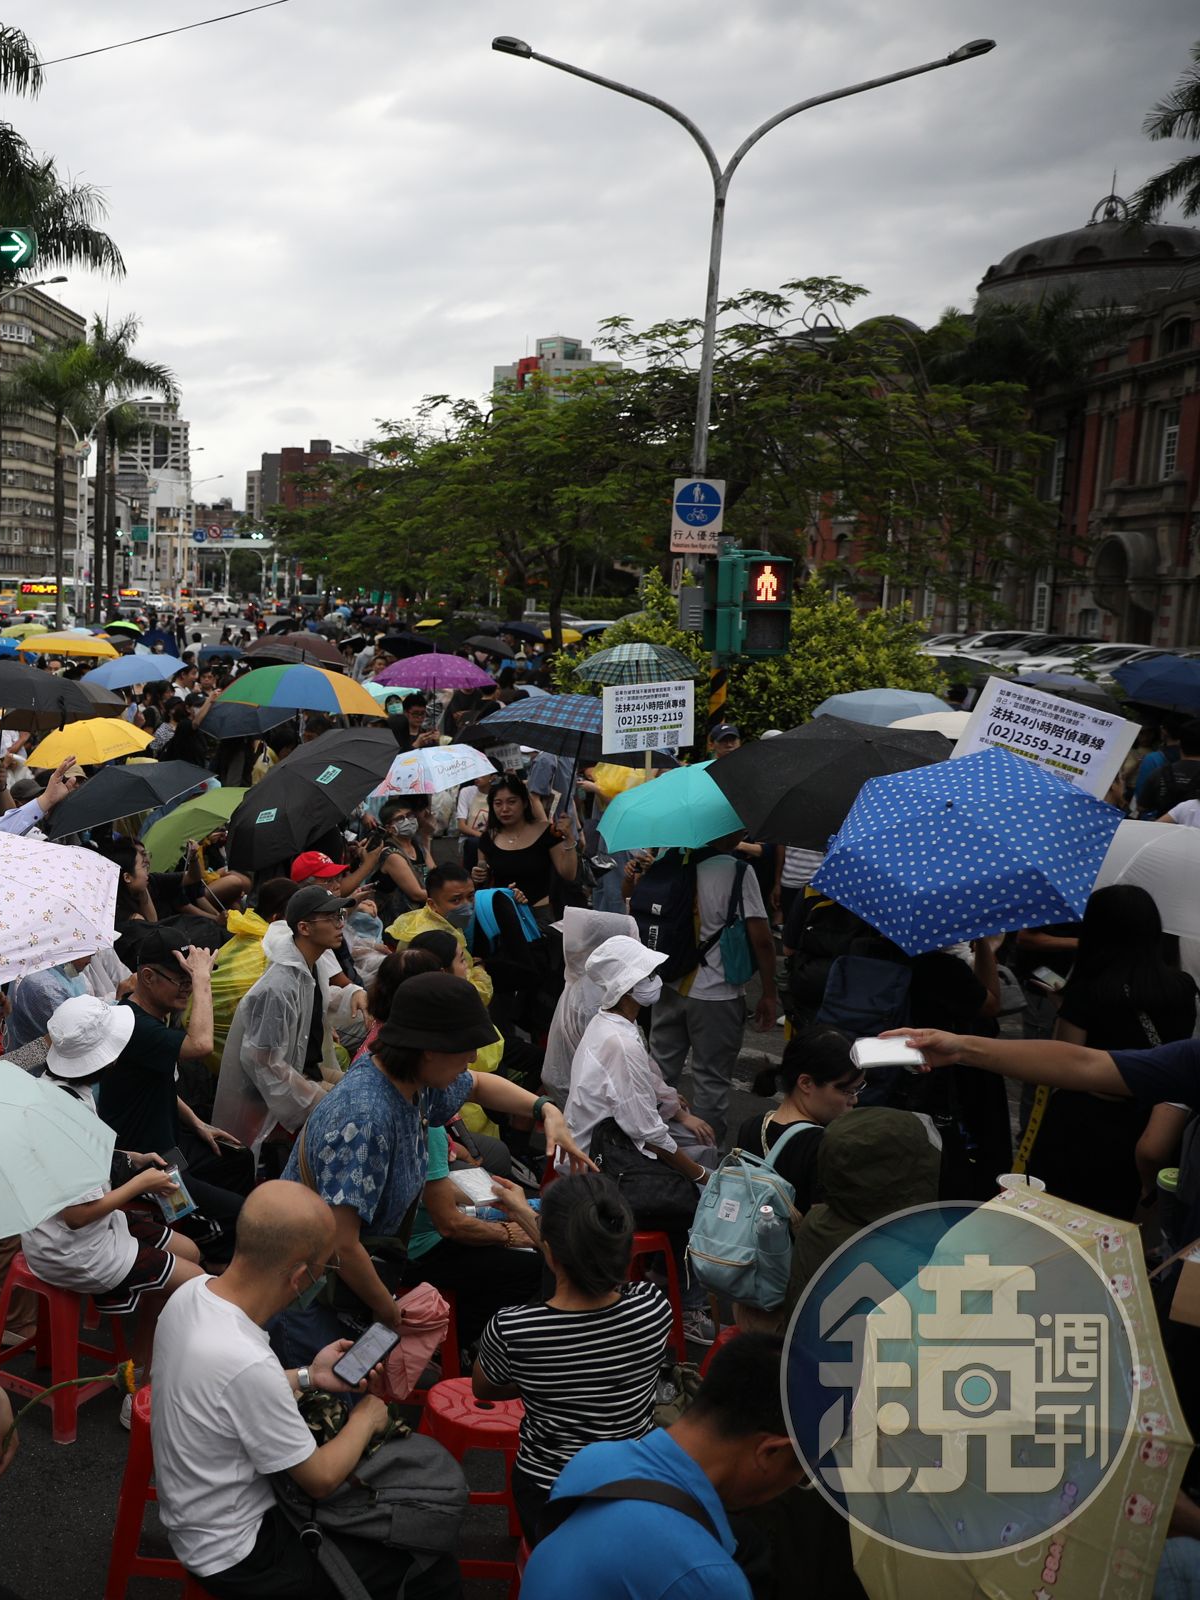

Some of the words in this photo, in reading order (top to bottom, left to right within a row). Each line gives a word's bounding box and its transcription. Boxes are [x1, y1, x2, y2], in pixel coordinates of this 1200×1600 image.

[673, 530, 719, 541] 行人優先
[617, 711, 684, 728] (02)2559-2119
[988, 704, 1105, 751] 法扶24小時陪偵專線
[987, 721, 1092, 766] (02)2559-2119
